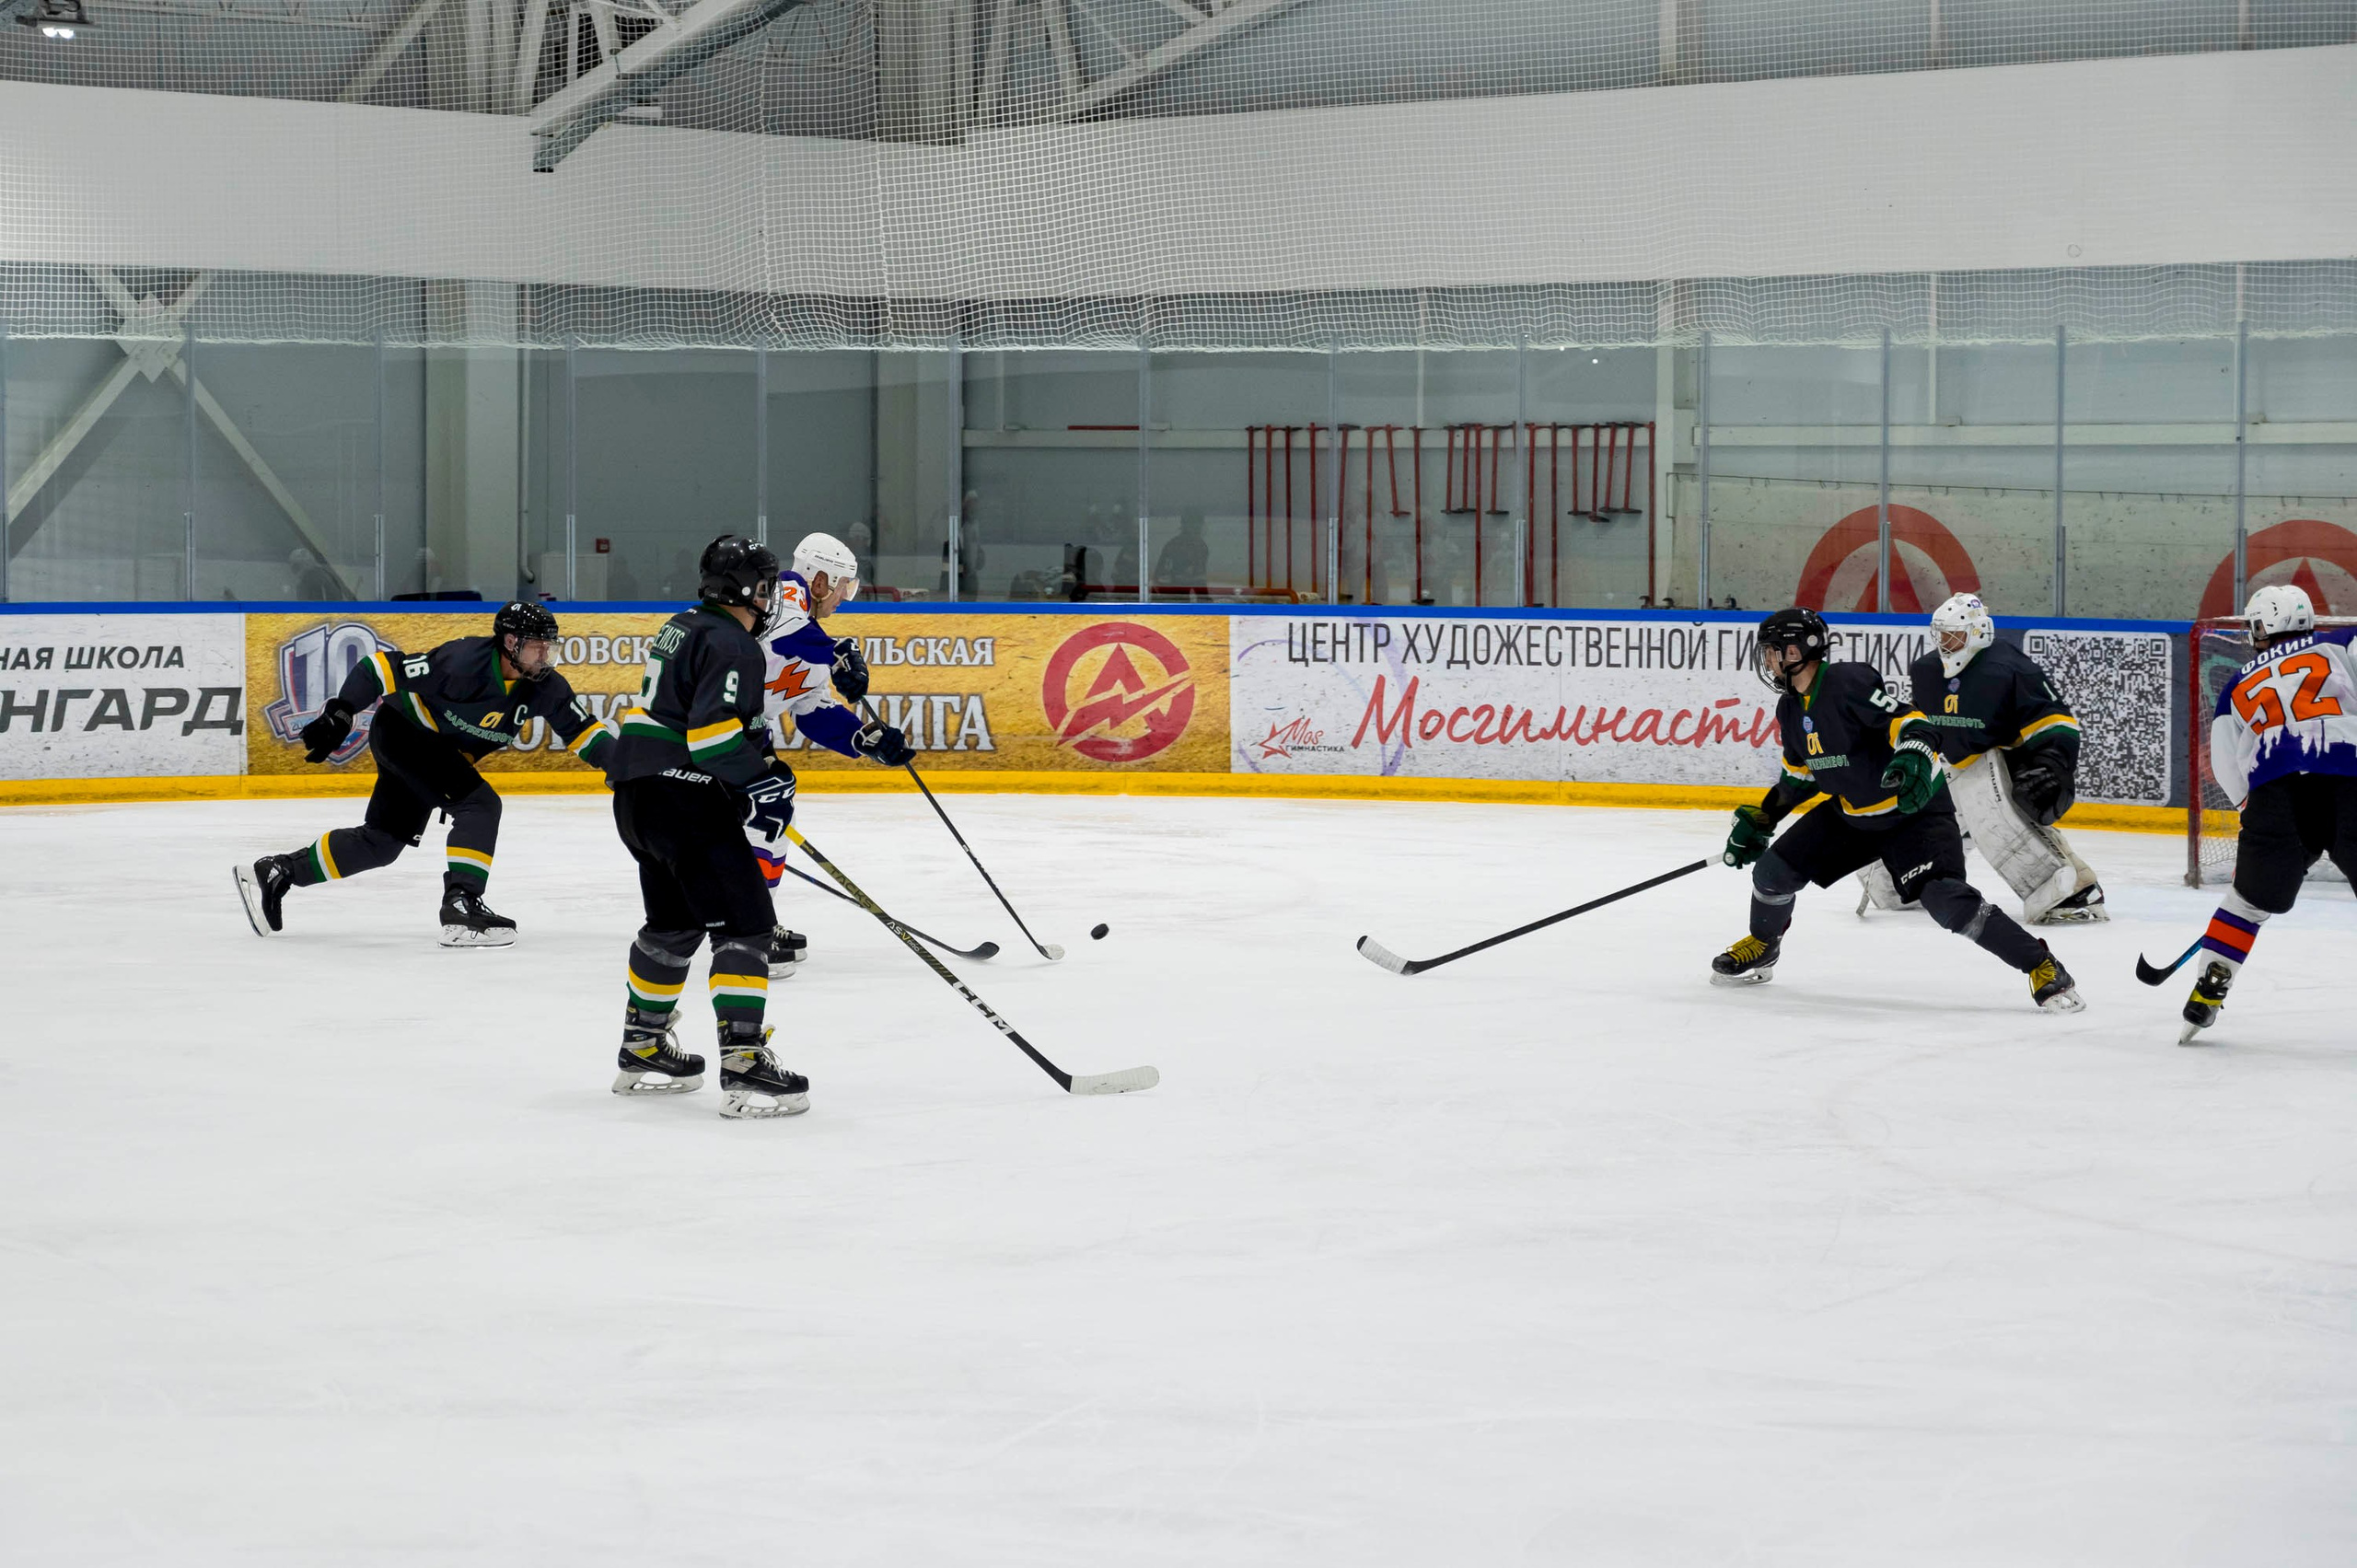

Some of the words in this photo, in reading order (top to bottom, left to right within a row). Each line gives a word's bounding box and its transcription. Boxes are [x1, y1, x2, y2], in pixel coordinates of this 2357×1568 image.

[64, 645, 185, 669] ШКОЛА
[402, 655, 430, 679] 16
[1288, 622, 1391, 668] ЦЕНТР
[1401, 621, 1707, 669] ХУДОЖЕСТВЕННОЙ
[1717, 629, 1926, 677] ГИСТИКИ
[2241, 636, 2314, 675] ФОКИН
[723, 670, 739, 704] 9
[1869, 689, 1898, 713] 5
[2231, 652, 2343, 736] 52
[1351, 673, 1784, 749] Мосгимнасти
[758, 784, 797, 804] CC
[829, 865, 874, 910] TACKS
[1900, 861, 1933, 886] CCM
[953, 981, 1015, 1035] CCM
